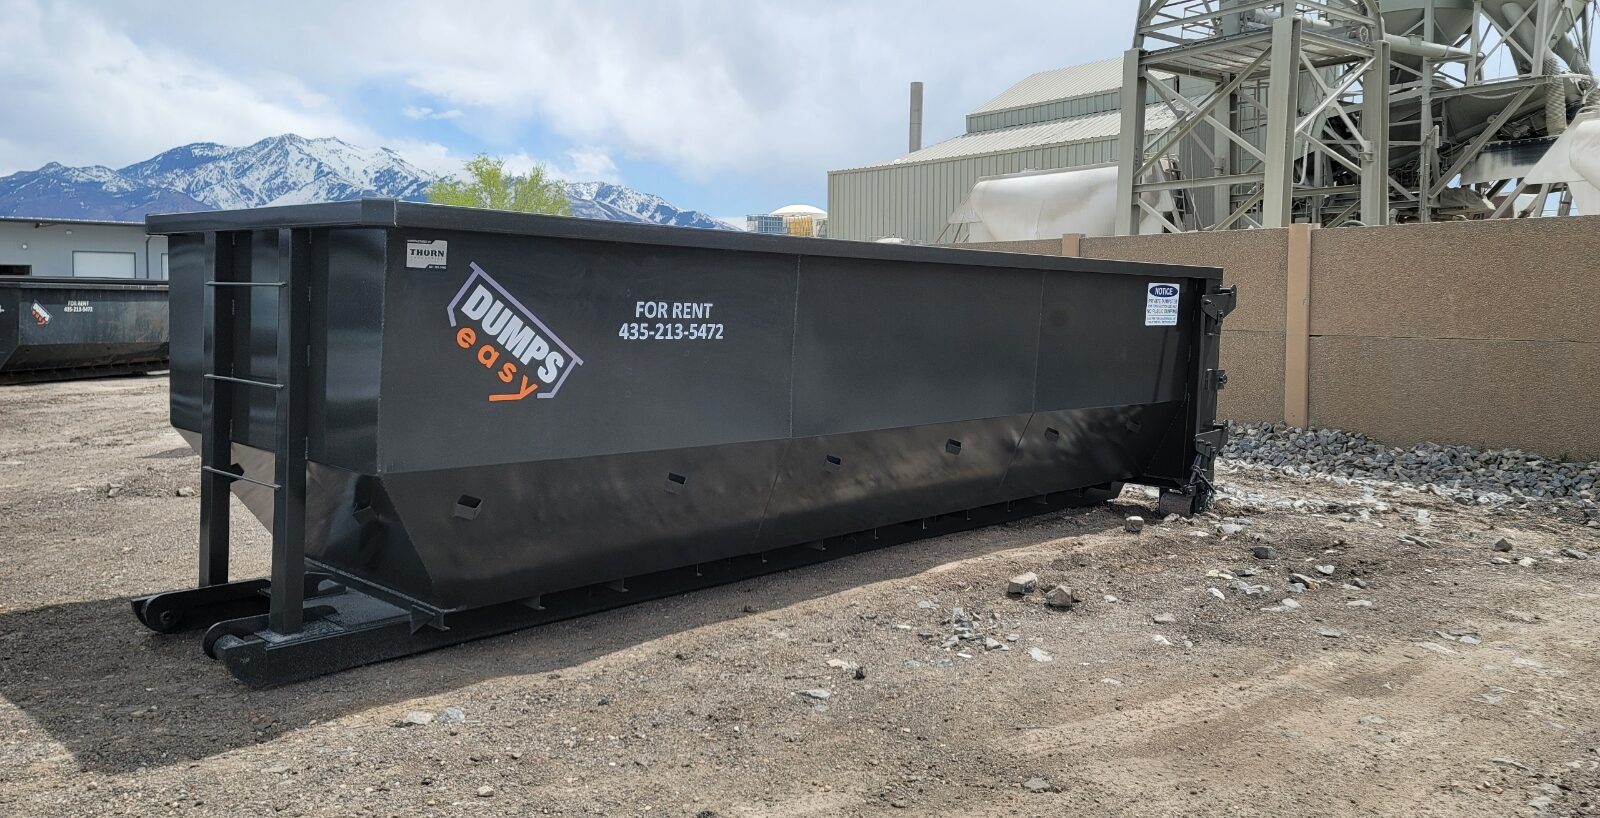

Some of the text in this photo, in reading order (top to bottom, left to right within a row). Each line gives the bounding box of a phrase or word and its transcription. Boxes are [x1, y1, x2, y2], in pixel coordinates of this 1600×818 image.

[409, 248, 445, 257] THORN
[1154, 287, 1174, 295] NOTICE
[635, 301, 714, 319] FOR RENT
[461, 284, 565, 383] DUMPS
[618, 323, 724, 340] 435-213-5472
[456, 327, 538, 401] easy
